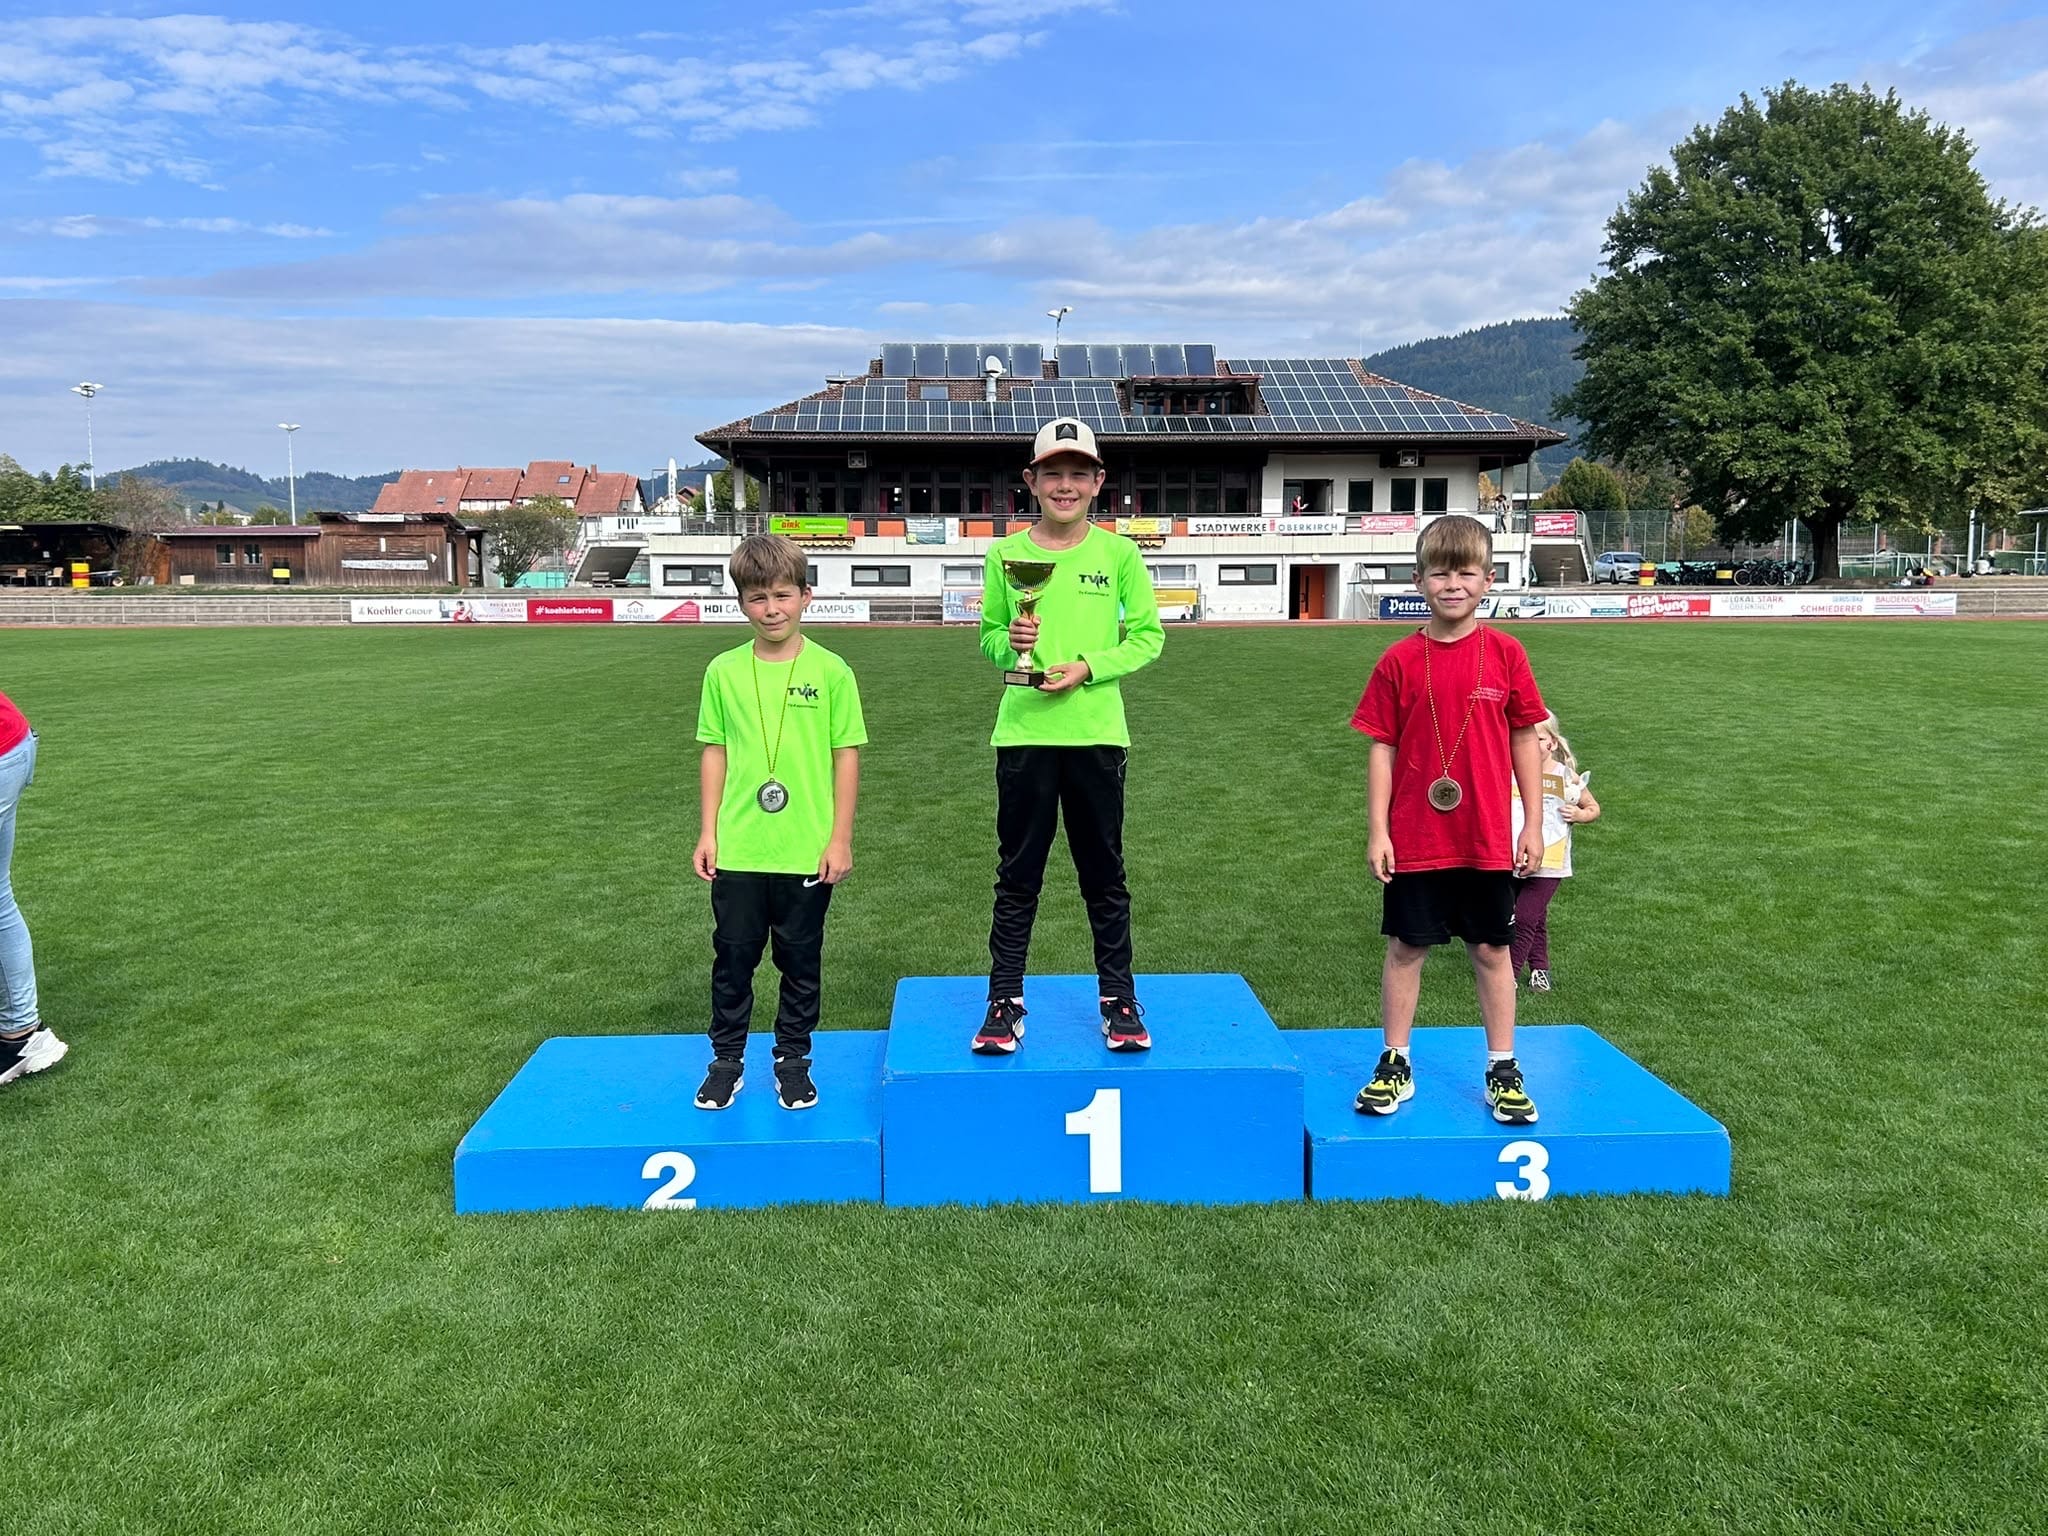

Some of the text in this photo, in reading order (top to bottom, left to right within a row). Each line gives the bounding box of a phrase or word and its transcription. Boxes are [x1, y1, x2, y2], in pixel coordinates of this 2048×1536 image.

[1195, 523, 1338, 532] STADTWERKE OBERKIRCH
[1388, 598, 1431, 614] Peters
[1629, 594, 1659, 607] elan
[1729, 595, 1784, 603] LOKAL STARK
[810, 604, 855, 614] CAMPUS
[1630, 600, 1689, 617] werbung
[1800, 604, 1863, 613] SCHMIEDERER
[1065, 1088, 1122, 1193] 1
[1495, 1140, 1550, 1202] 3
[641, 1151, 697, 1210] 2
